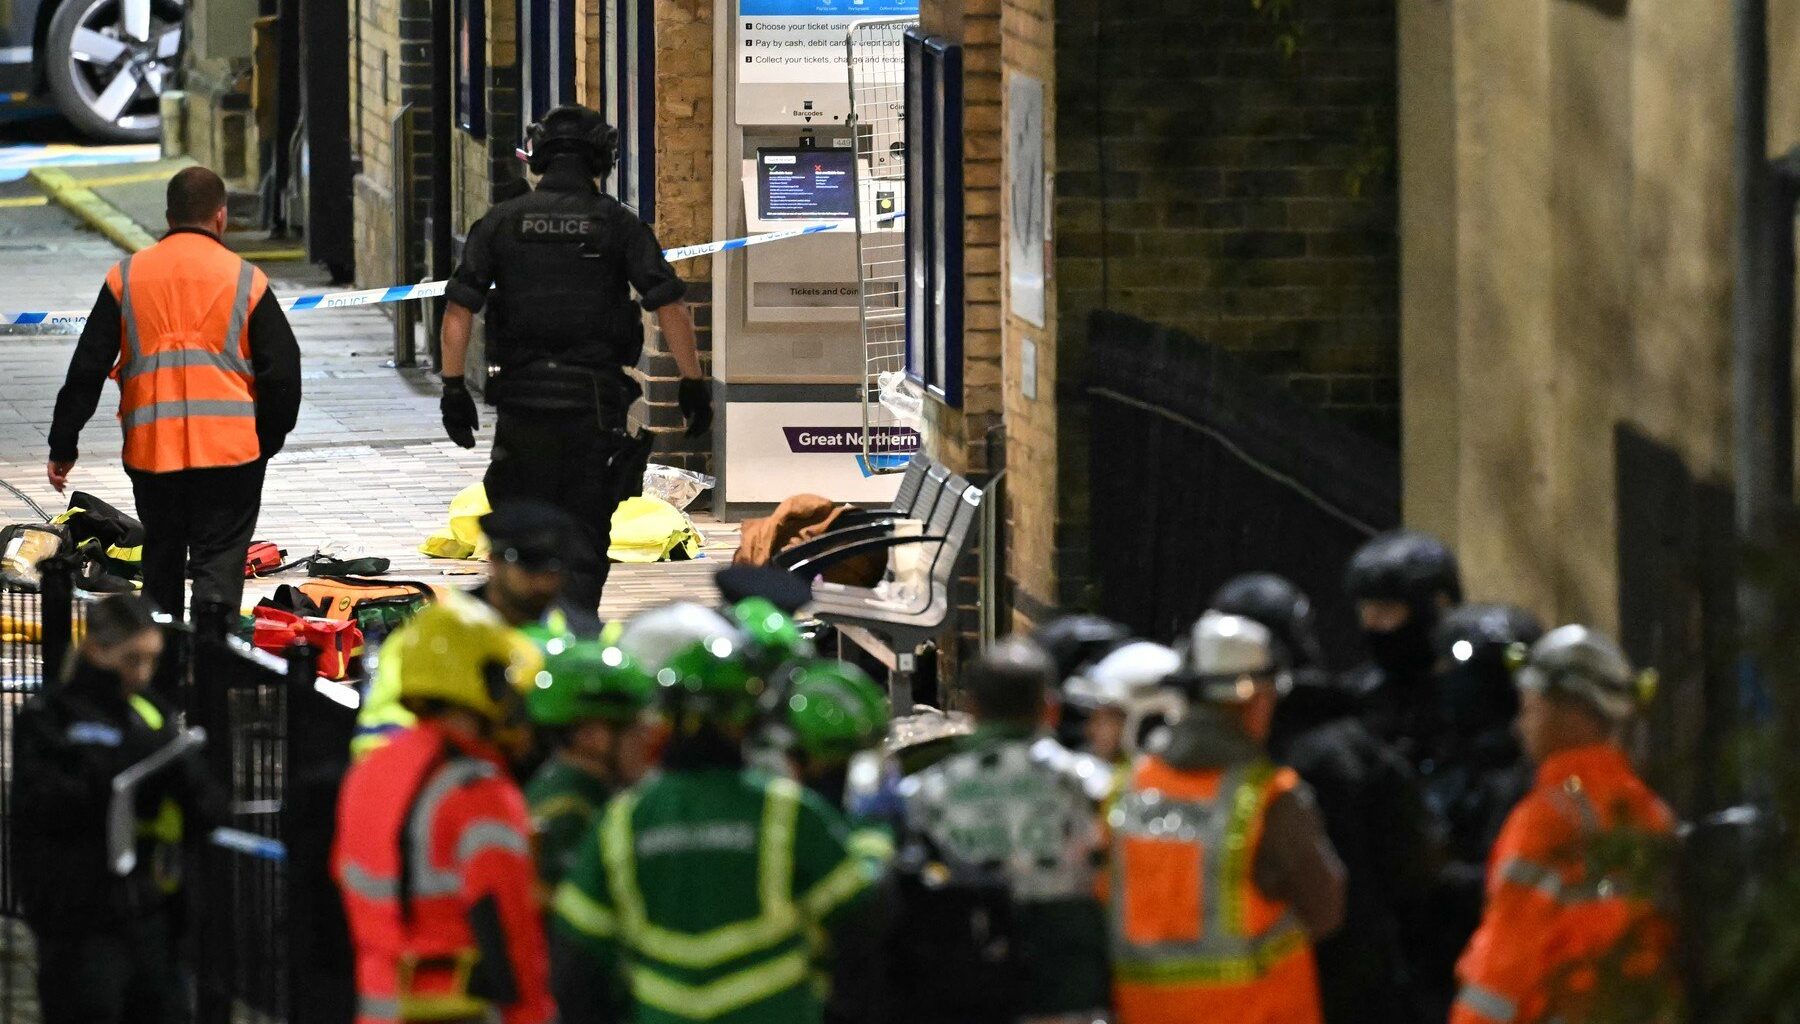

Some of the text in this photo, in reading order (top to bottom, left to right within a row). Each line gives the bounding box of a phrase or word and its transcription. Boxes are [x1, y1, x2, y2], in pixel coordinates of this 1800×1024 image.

[788, 24, 806, 32] your
[830, 23, 850, 31] usin
[755, 40, 771, 48] Pay
[773, 40, 782, 48] by
[784, 40, 806, 48] cash,
[755, 56, 784, 64] Collect
[784, 57, 802, 65] your
[803, 56, 832, 64] tickets,
[833, 56, 863, 65] chage
[805, 137, 810, 145] 1
[521, 219, 592, 234] POLICE
[790, 287, 820, 296] Tickets
[821, 287, 838, 296] and
[798, 432, 843, 446] Great
